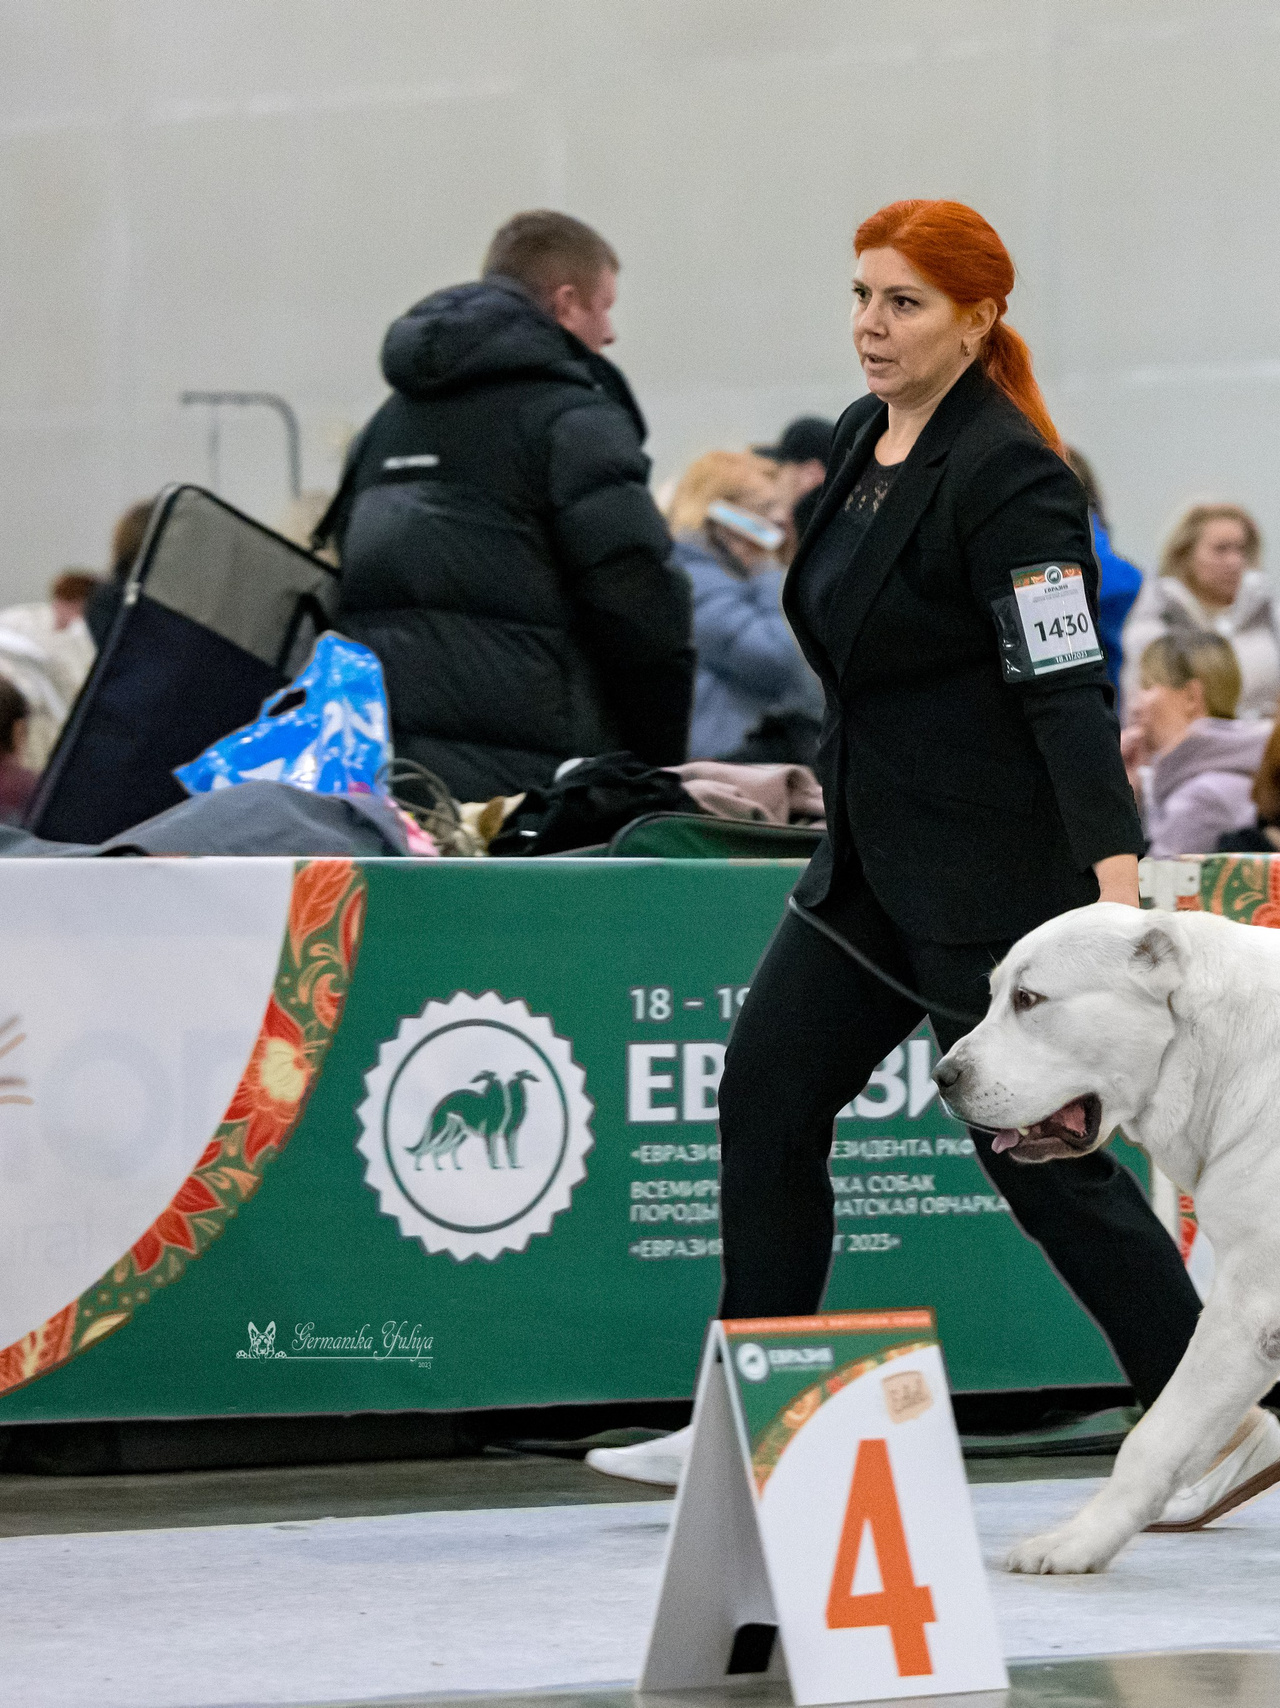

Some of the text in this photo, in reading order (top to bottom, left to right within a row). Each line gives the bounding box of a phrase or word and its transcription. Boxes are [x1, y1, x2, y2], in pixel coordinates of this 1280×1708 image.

[1034, 612, 1089, 642] 1430
[630, 988, 671, 1020] 18
[824, 1437, 938, 1677] 4
